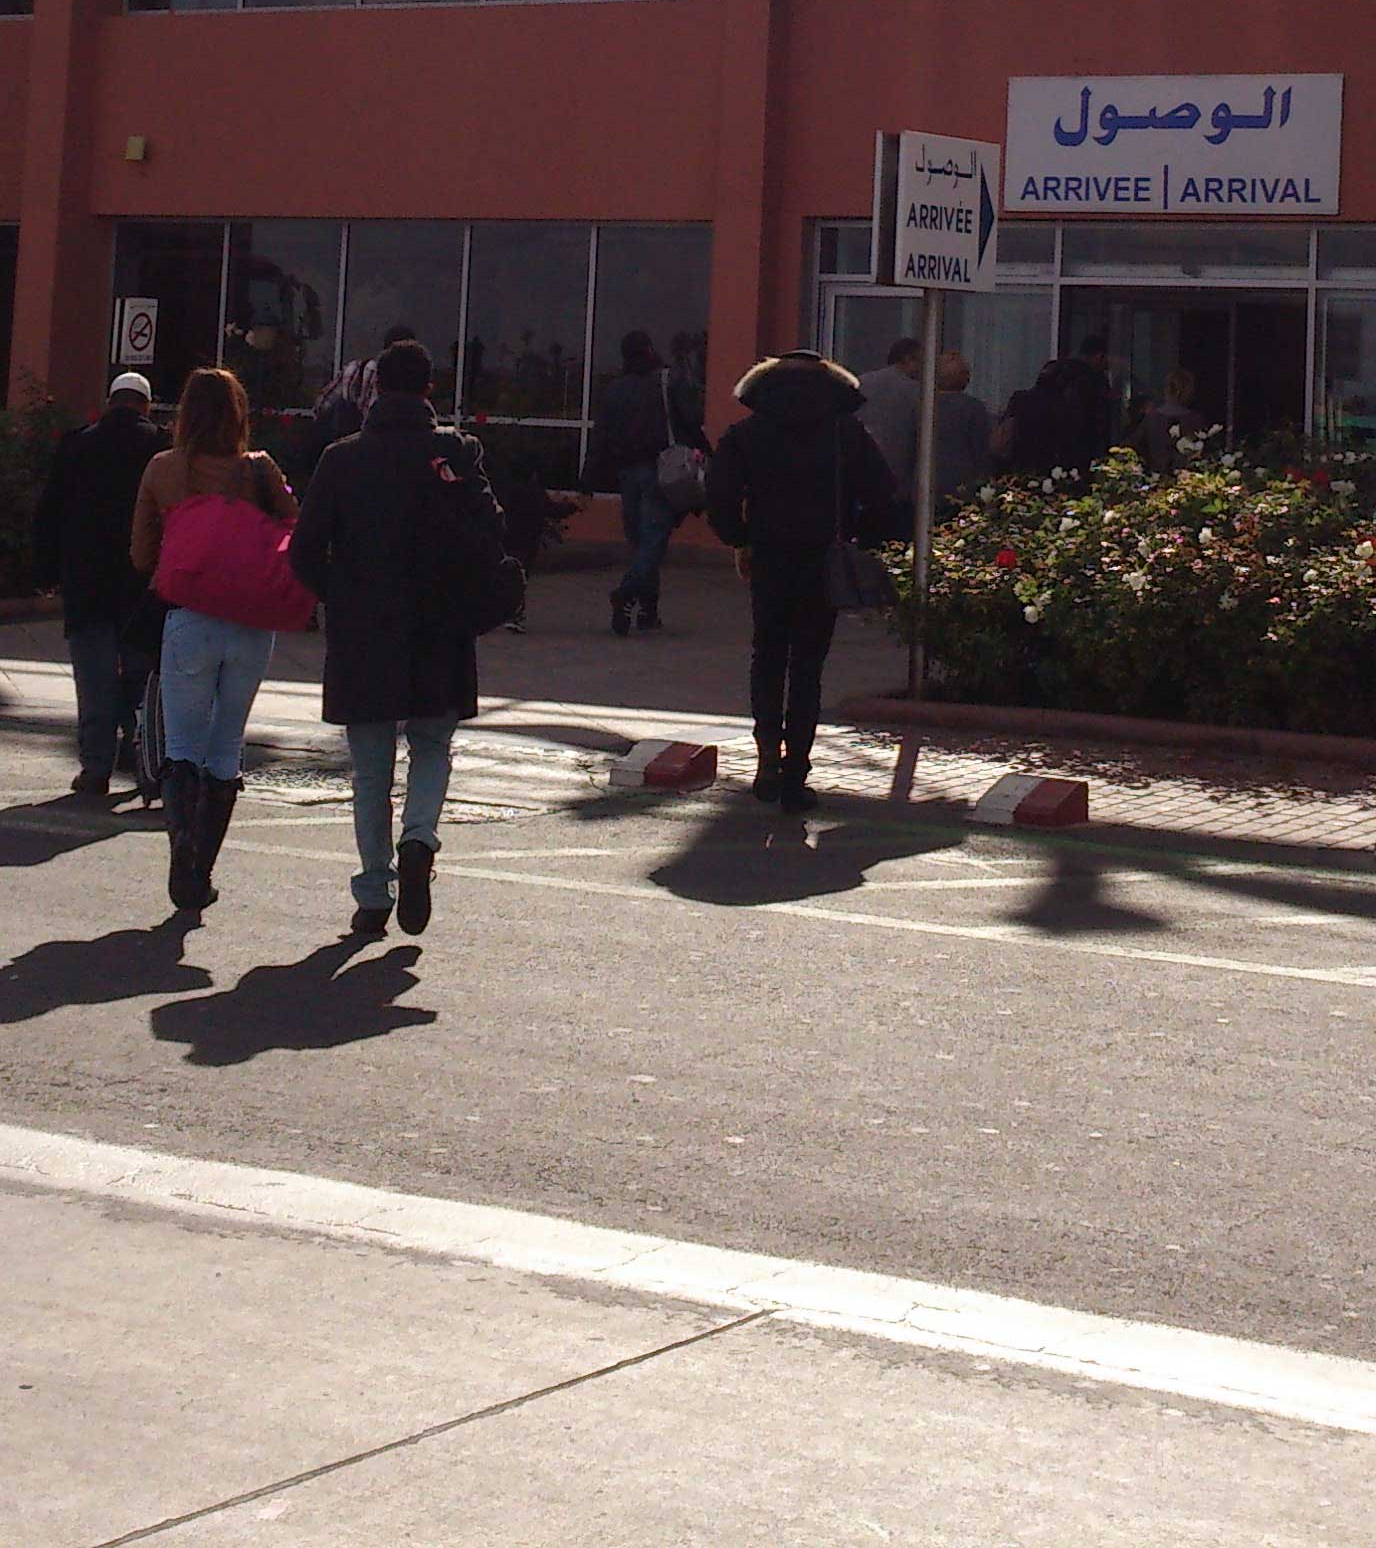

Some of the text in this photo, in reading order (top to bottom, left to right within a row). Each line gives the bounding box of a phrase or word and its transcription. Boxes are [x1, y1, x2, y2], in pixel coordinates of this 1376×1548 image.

[1053, 85, 1292, 147] الوصول
[1020, 175, 1322, 204] ARRIVEE ARRIVAL
[906, 200, 973, 234] ARRIVÉE
[904, 253, 971, 283] ARRIVAL
